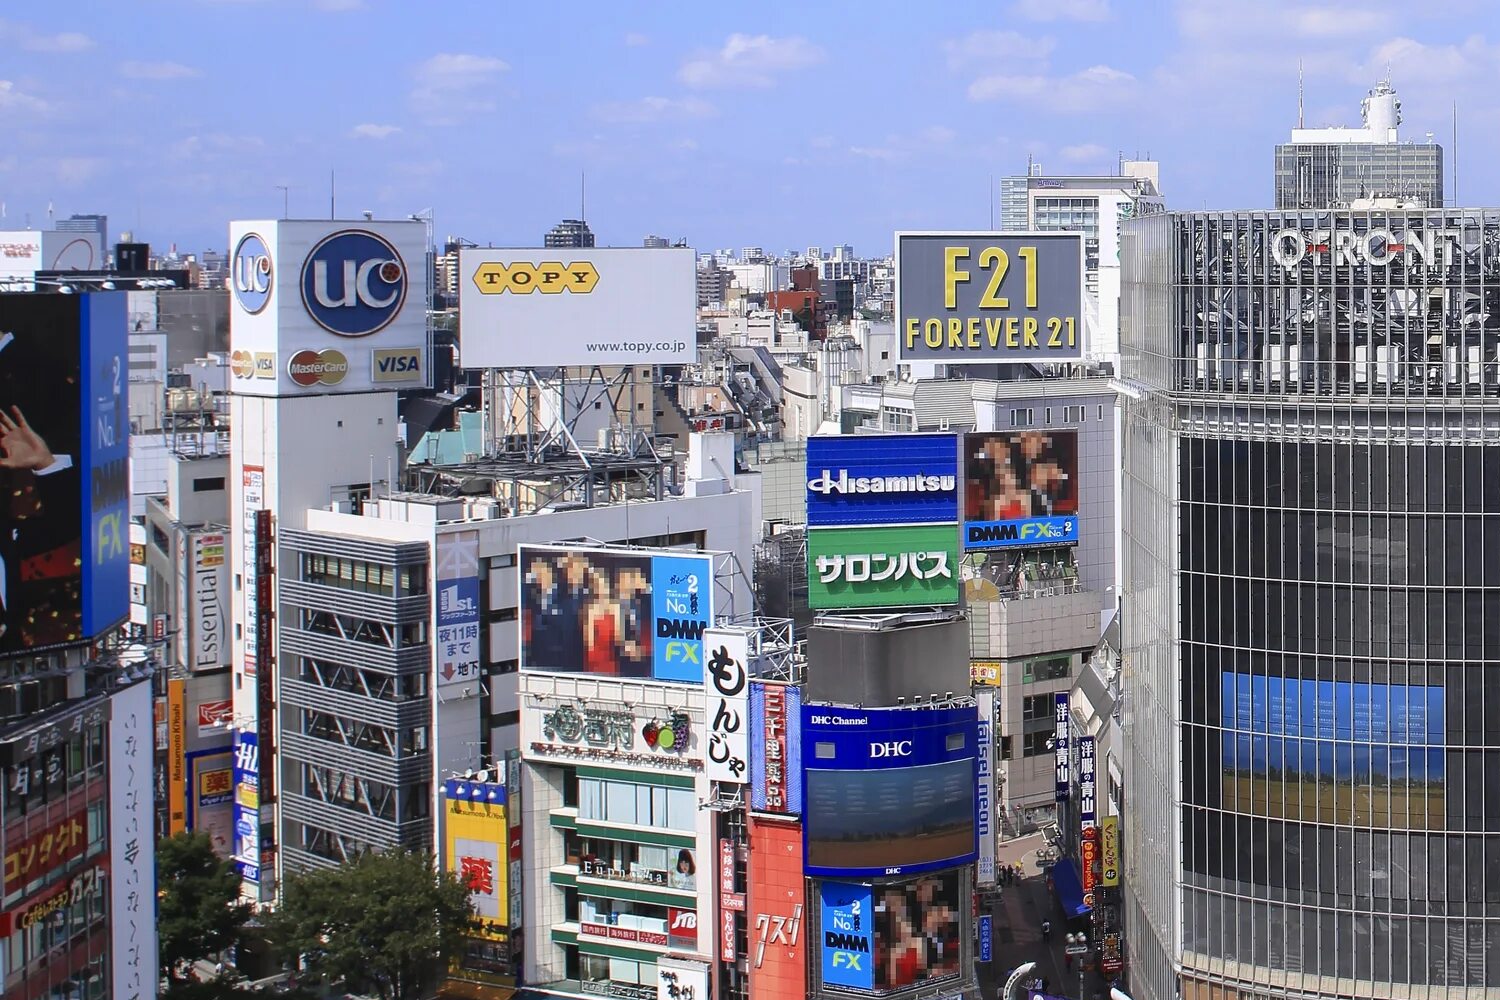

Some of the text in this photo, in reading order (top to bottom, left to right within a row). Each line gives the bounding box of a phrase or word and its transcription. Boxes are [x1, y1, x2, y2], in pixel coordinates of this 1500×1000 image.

[313, 258, 402, 309] UC
[483, 271, 590, 285] TOPY
[944, 246, 1039, 309] F21
[906, 316, 1076, 348] FOREVER 21
[586, 340, 686, 354] www.topy.co.jp
[256, 357, 273, 371] VISA
[290, 359, 347, 376] MasterCard
[377, 355, 419, 373] VISA
[807, 469, 955, 495] Hisamitsu
[97, 511, 122, 565] FX
[969, 521, 1051, 543] DMM FX
[815, 551, 952, 584] サロンパス
[197, 570, 218, 666] Essential
[657, 617, 707, 640] DMM
[439, 625, 478, 643] 夜11時
[447, 641, 471, 656] まで
[665, 641, 699, 665] FX
[457, 661, 478, 676] 地下
[708, 645, 745, 778] もんじゃ
[811, 715, 868, 726] DHC Channel
[765, 691, 782, 807] 三千里薬品
[870, 740, 912, 758] DHC
[1056, 702, 1068, 784] 洋服の青山
[1081, 740, 1094, 814] 洋服の青山
[979, 781, 990, 836] neon
[4, 818, 83, 884] コンタクト
[461, 855, 494, 895] 薬
[723, 843, 734, 890] お好み焼
[70, 865, 106, 905] ガスト
[582, 924, 637, 940] 国内旅行 海外旅行
[671, 911, 697, 930] JTB
[724, 910, 734, 959] もんじゃ焼
[825, 931, 869, 953] DMM
[832, 952, 861, 971] FX
